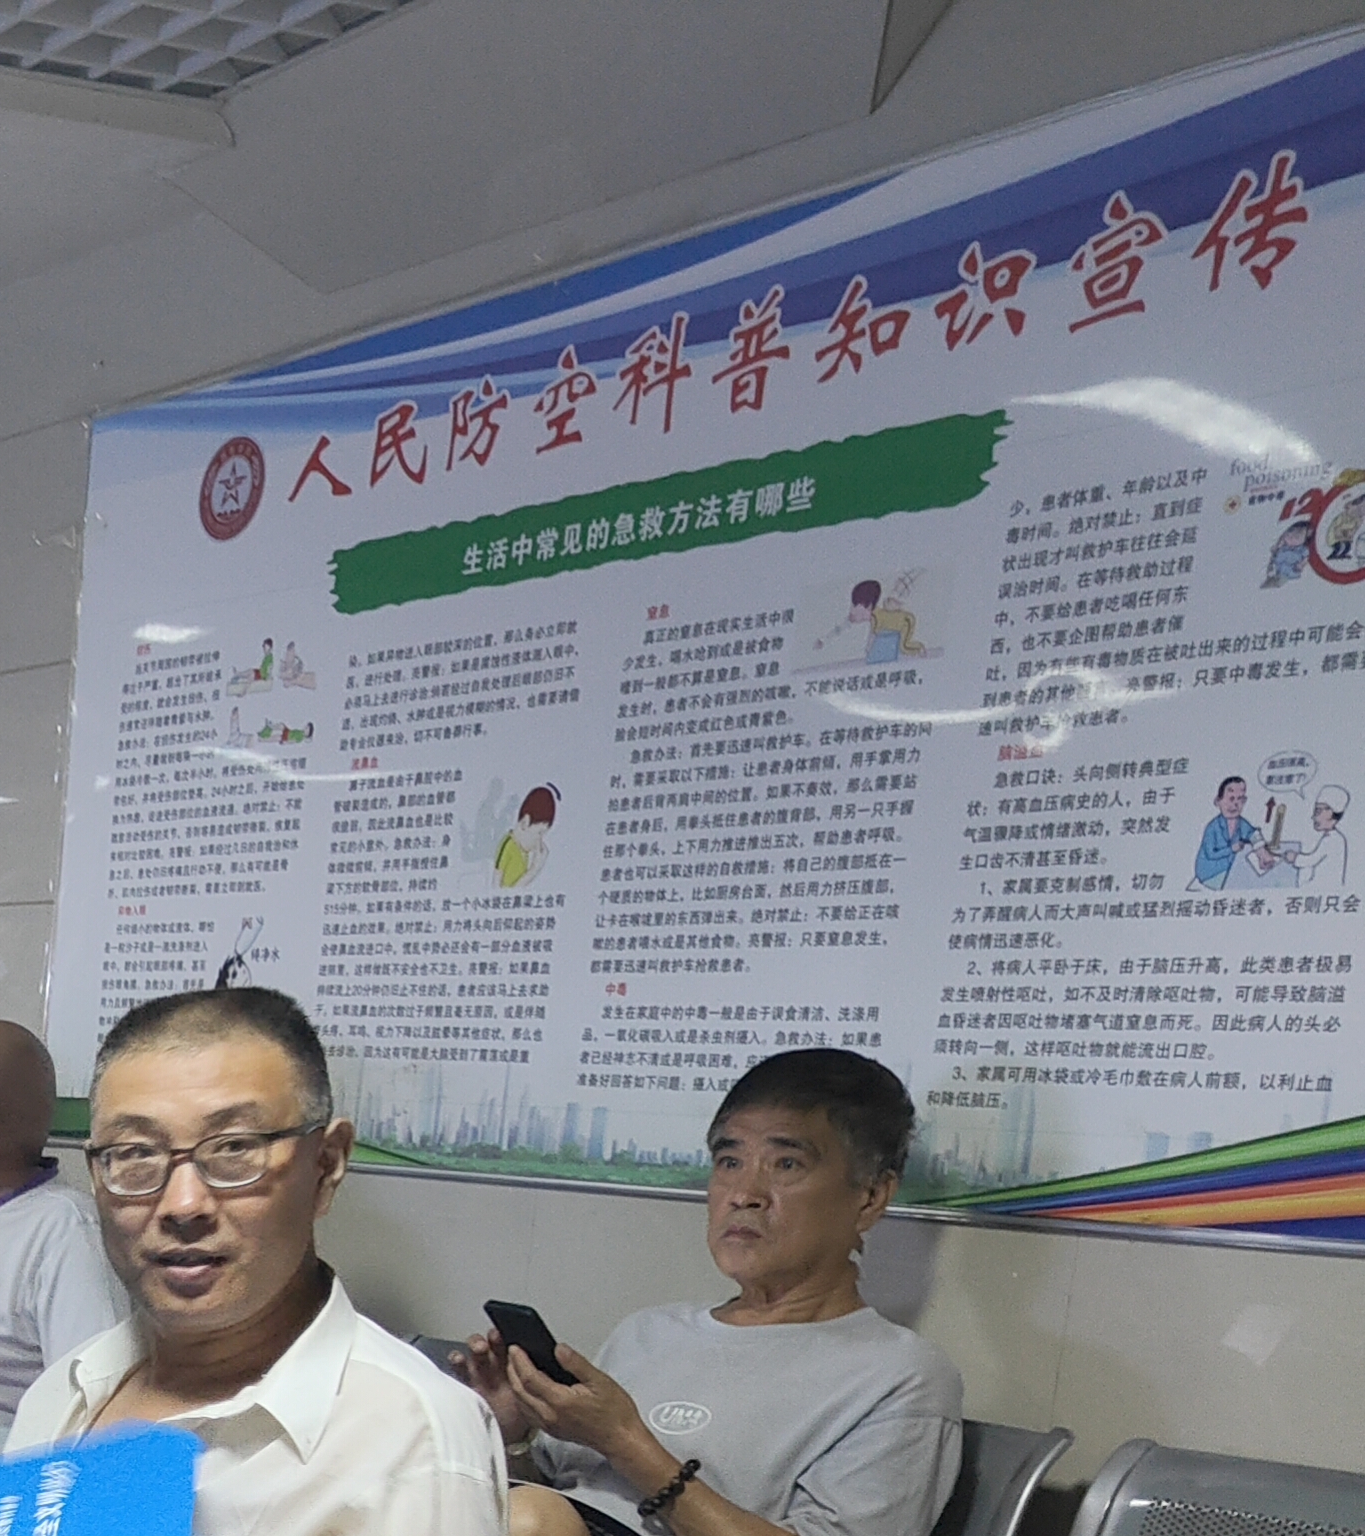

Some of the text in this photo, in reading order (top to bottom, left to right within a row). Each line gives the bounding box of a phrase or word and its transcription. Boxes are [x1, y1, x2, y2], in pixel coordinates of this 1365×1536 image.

[287, 148, 1310, 503] 人民防空科普知识宣传
[462, 476, 816, 576] 生活中常见的急救方法有哪些
